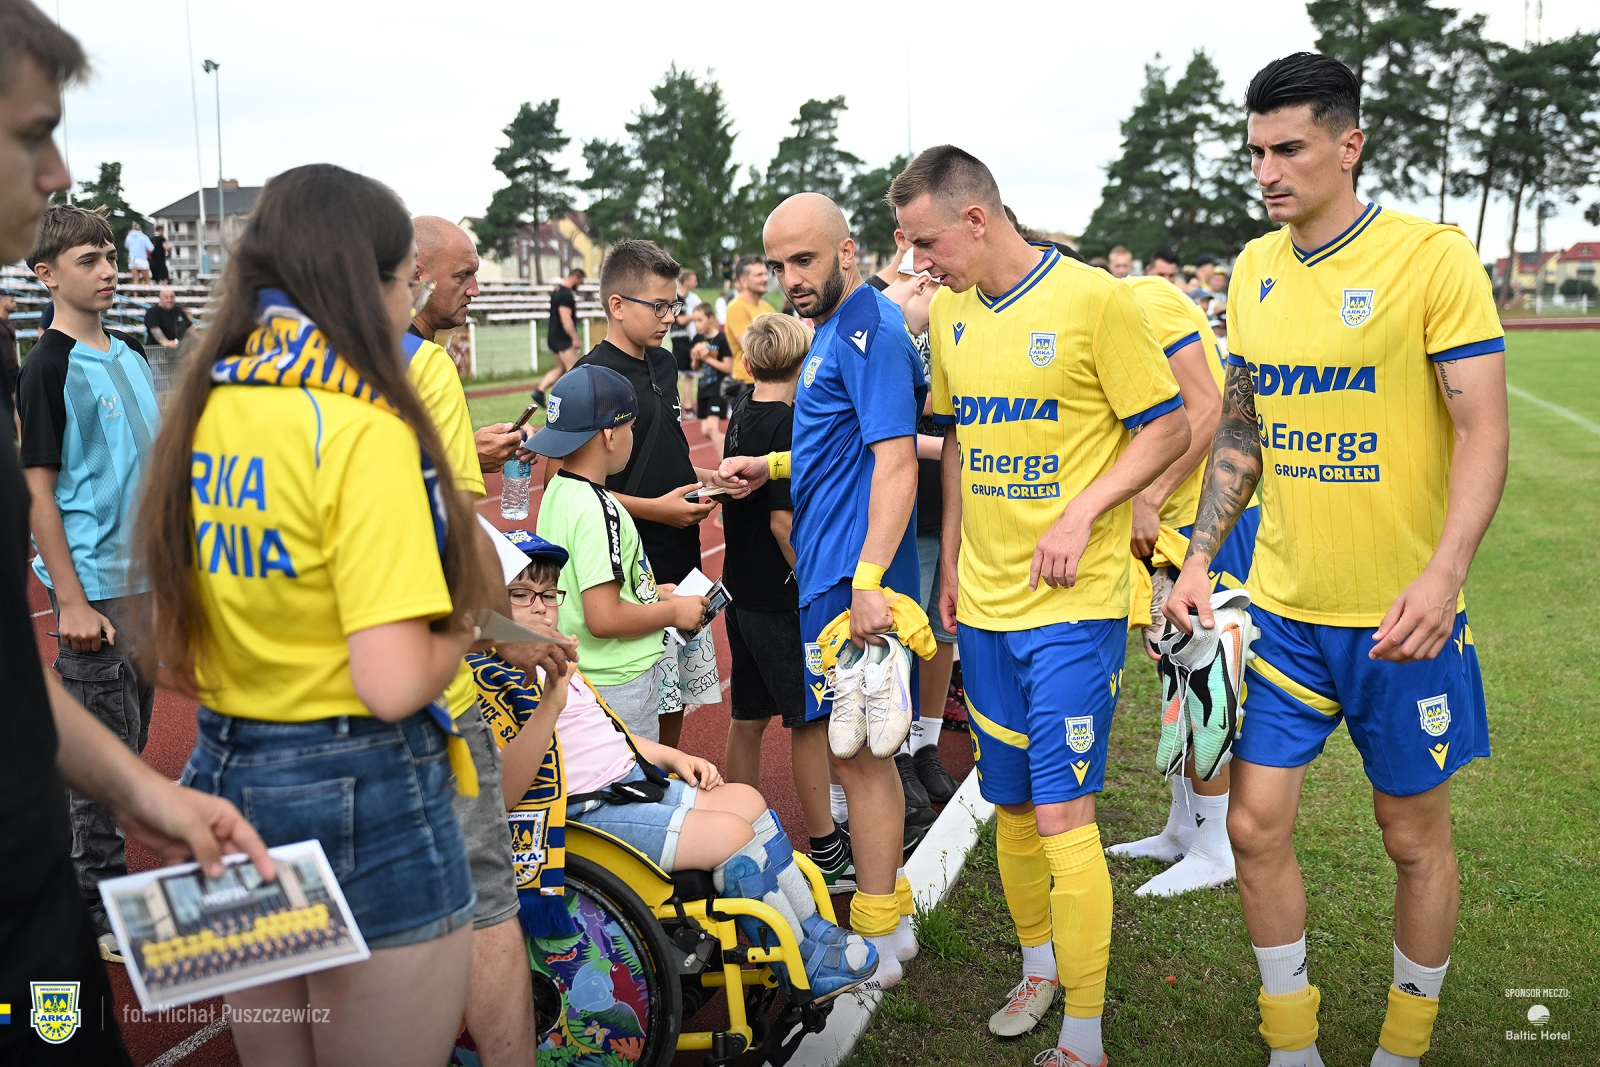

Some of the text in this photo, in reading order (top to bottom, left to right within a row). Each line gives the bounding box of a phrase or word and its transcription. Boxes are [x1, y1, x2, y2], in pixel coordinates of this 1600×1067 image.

[961, 379, 1031, 394] CATAPULT
[1247, 362, 1376, 396] GDYNIA
[1437, 358, 1463, 400] onsuelo
[952, 395, 1059, 426] GDYNIA
[1272, 423, 1378, 462] Energa
[191, 451, 266, 511] RKA
[970, 448, 1059, 481] Energa
[1275, 464, 1377, 481] GRUPA ORLEN
[972, 483, 1058, 498] GRUPA ORLEN
[197, 521, 298, 579] YNIA
[609, 520, 620, 565] SONIC
